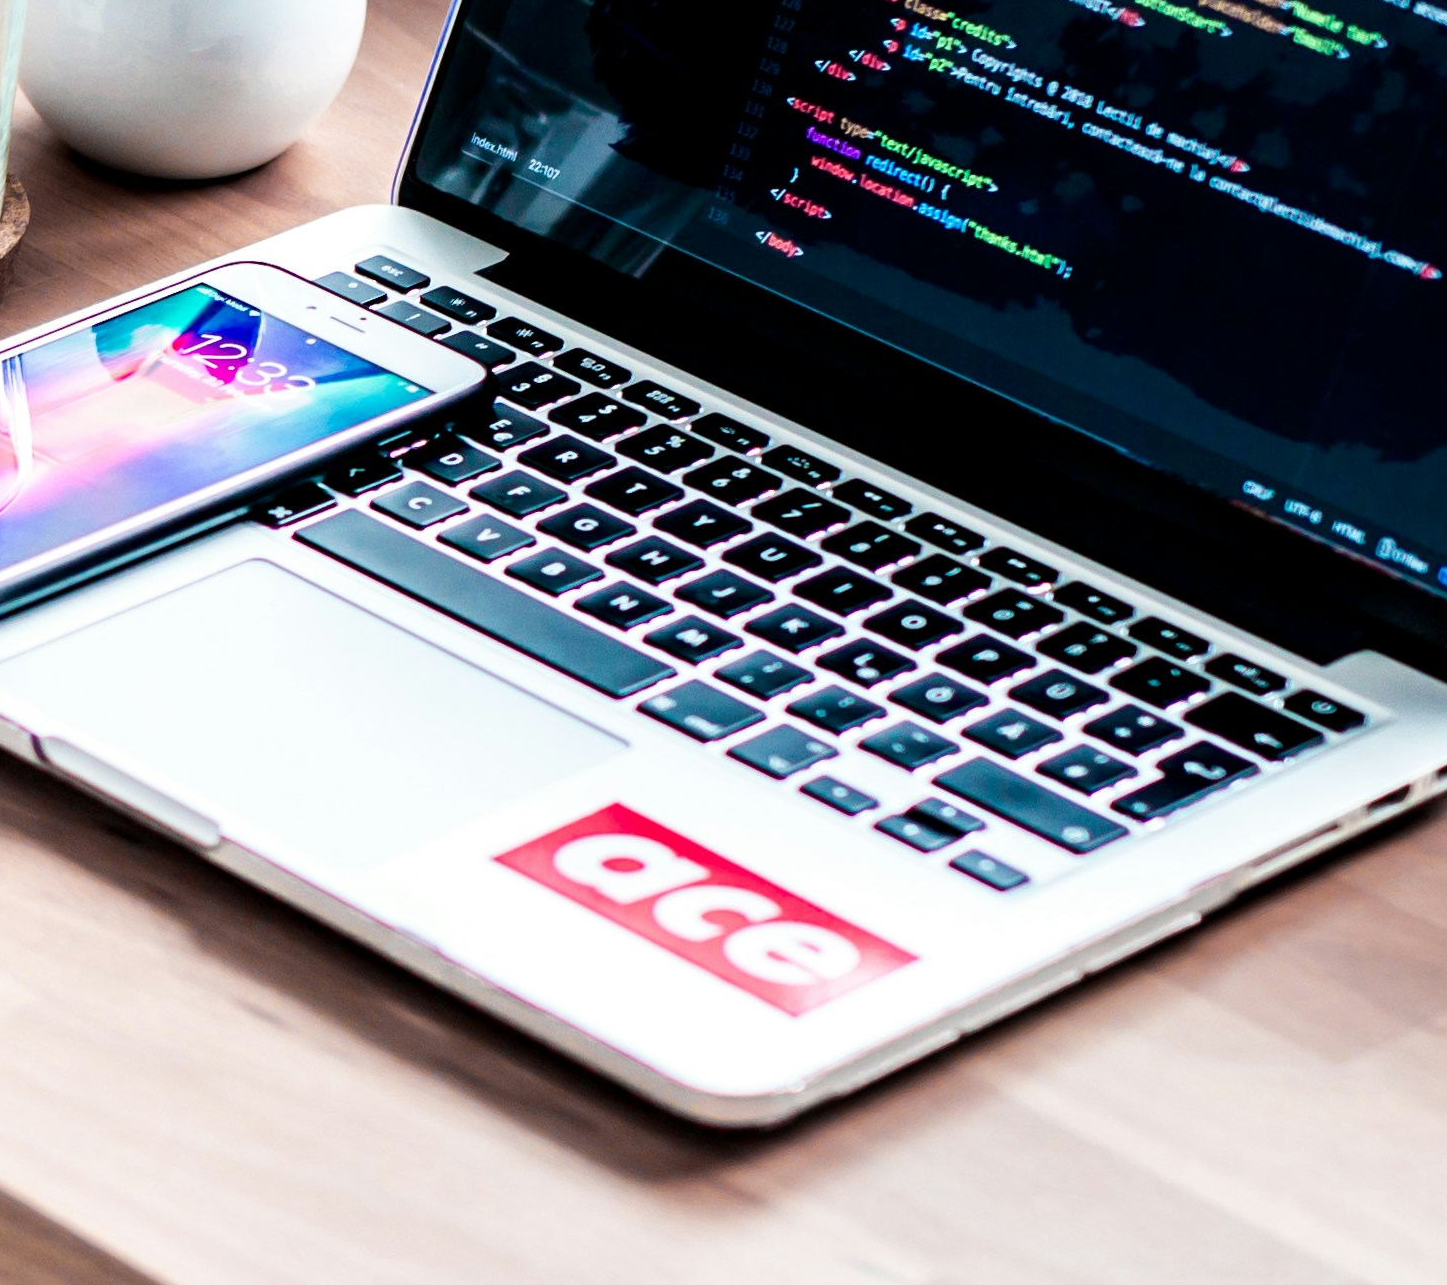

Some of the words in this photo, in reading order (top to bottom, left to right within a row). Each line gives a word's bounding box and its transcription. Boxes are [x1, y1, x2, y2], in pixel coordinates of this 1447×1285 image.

[882, 39, 898, 53] <p
[848, 49, 891, 71] </div>
[814, 60, 856, 81] </div>
[890, 18, 906, 31] <p
[909, 22, 967, 54] id="p1">
[971, 48, 1043, 88] Copyrights
[1060, 85, 1094, 109] 2018
[1145, 123, 1164, 139] de
[786, 97, 834, 123] <script
[840, 118, 998, 192] type="text/javascript">
[470, 133, 518, 161] index.html
[528, 158, 560, 180] 22:107
[806, 126, 861, 160] function
[865, 155, 935, 192] redirect()
[769, 188, 831, 219] </script>
[811, 156, 1072, 279] window.location.assign("thanks.html");
[755, 231, 804, 257] </body>
[380, 265, 403, 276] esc
[180, 333, 317, 402] 12:33
[489, 419, 513, 432] E
[555, 450, 578, 463] R
[644, 446, 665, 454] 5
[439, 453, 463, 465] D
[625, 482, 647, 493] T
[712, 478, 729, 487] 6
[506, 485, 531, 495] F
[408, 497, 432, 509] C
[573, 518, 598, 531] G
[693, 515, 715, 526] Y
[476, 528, 500, 541] V
[640, 550, 669, 565] H
[760, 547, 786, 561] U
[711, 587, 735, 597] J
[609, 595, 638, 610] N
[780, 618, 808, 633] K
[900, 615, 926, 629] O
[675, 628, 707, 646] M
[551, 831, 863, 987] ace
